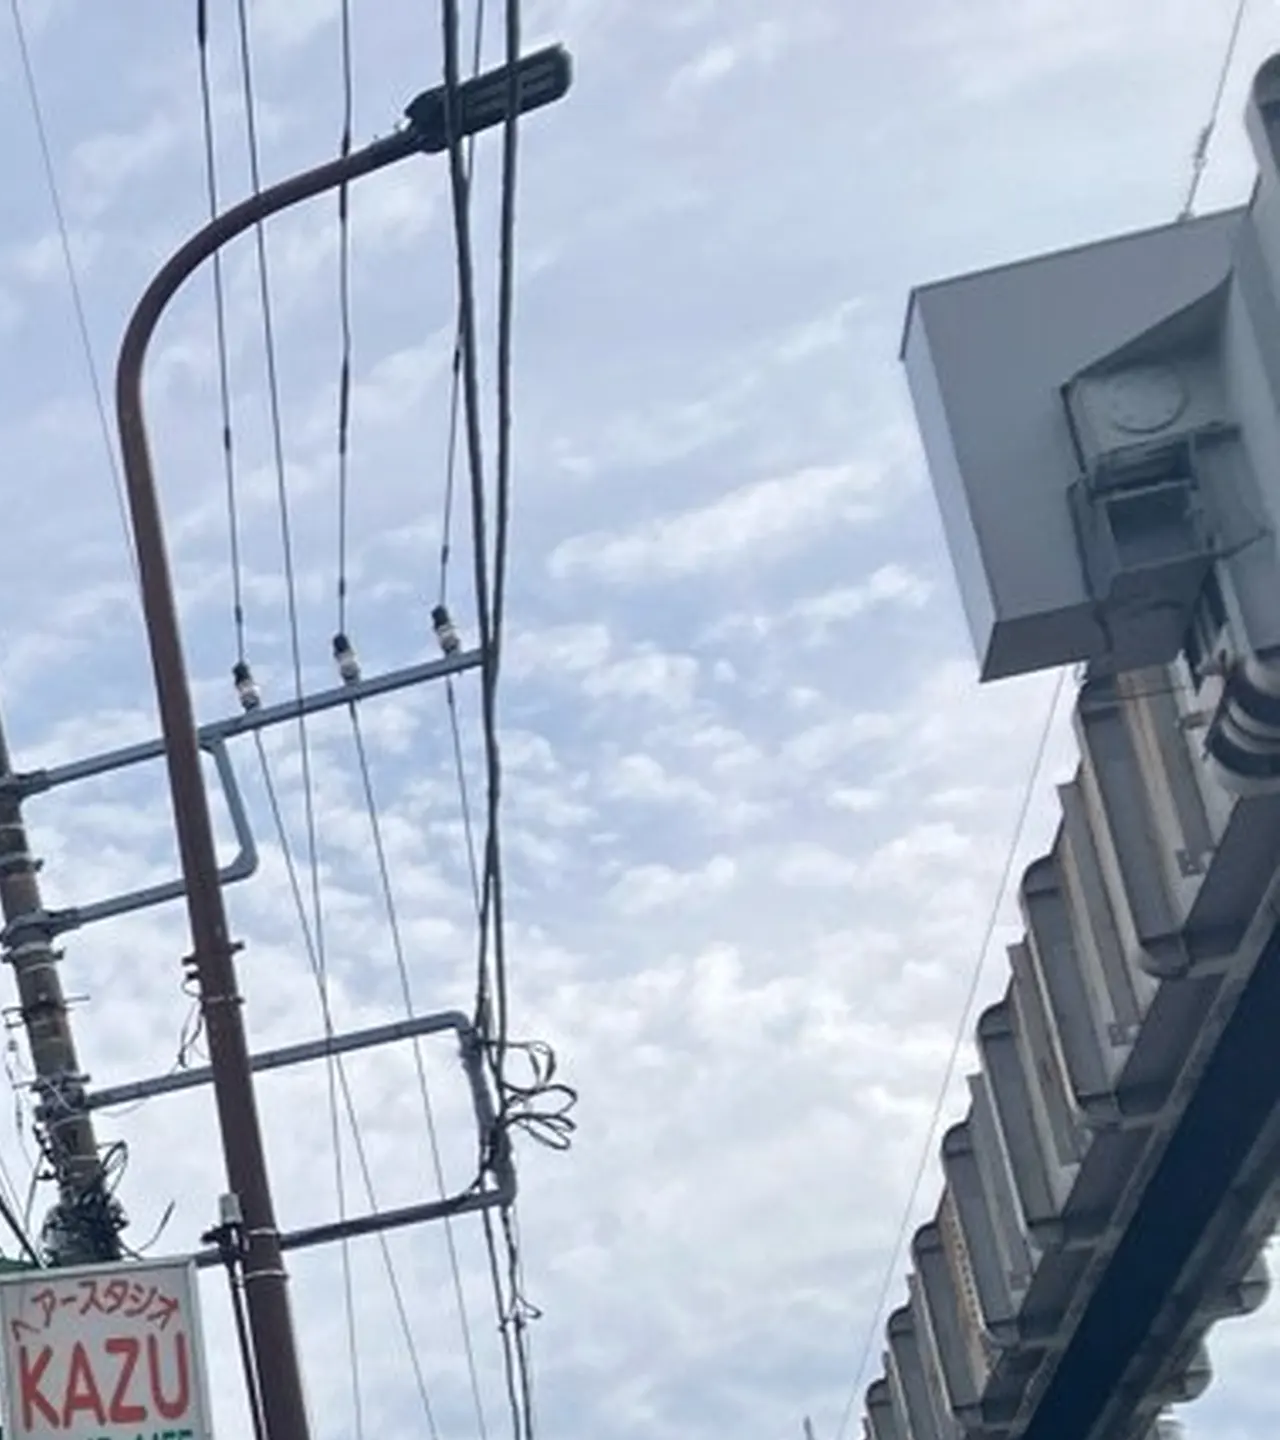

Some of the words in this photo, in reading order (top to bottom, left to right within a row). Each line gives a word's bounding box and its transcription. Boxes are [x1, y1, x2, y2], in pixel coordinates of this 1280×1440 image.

[10, 1280, 180, 1342] ヘアースタジオ
[17, 1331, 191, 1433] KAZU
